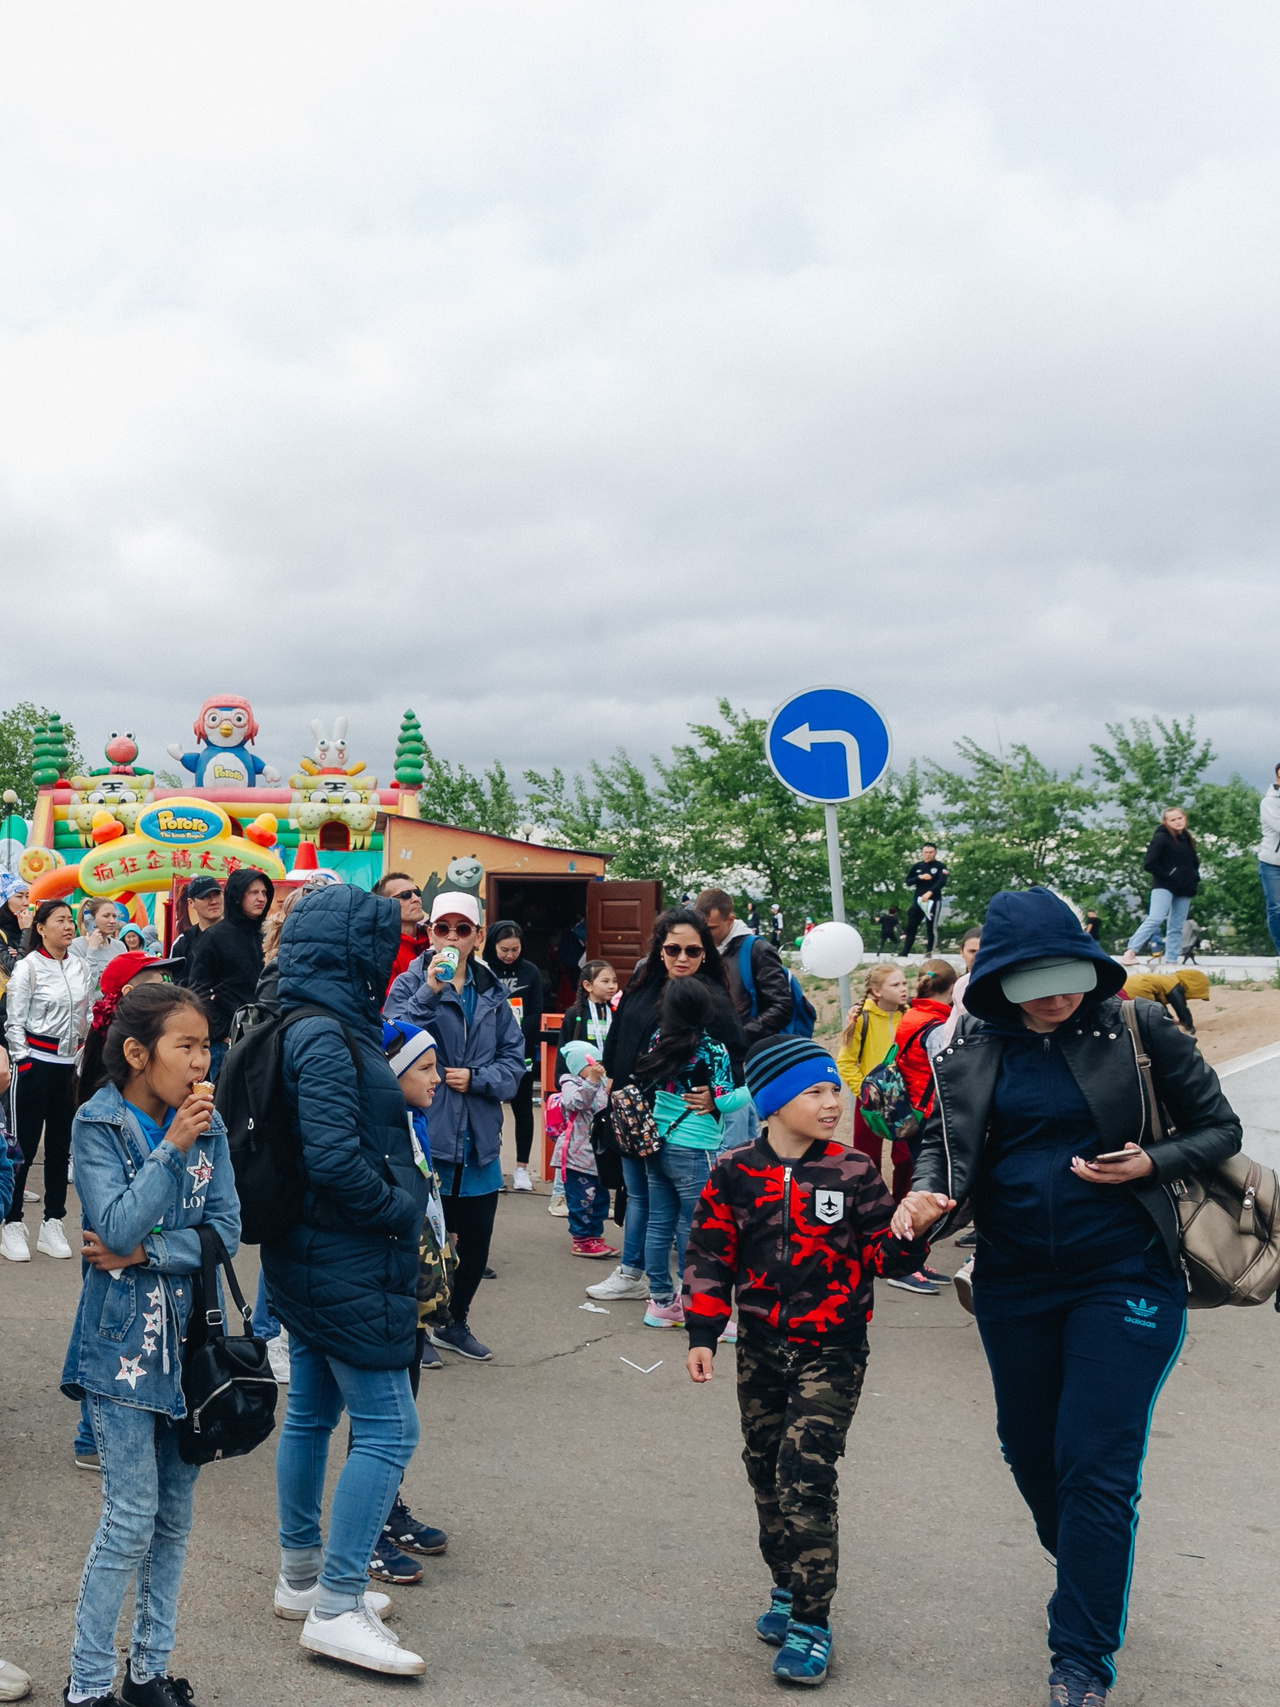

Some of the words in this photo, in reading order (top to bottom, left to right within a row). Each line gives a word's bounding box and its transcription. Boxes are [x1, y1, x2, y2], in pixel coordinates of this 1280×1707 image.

[213, 764, 244, 781] Pororo
[157, 809, 209, 833] Pororo
[93, 849, 269, 882] 疯狂企鹅大滑
[1124, 1315, 1157, 1329] adidas
